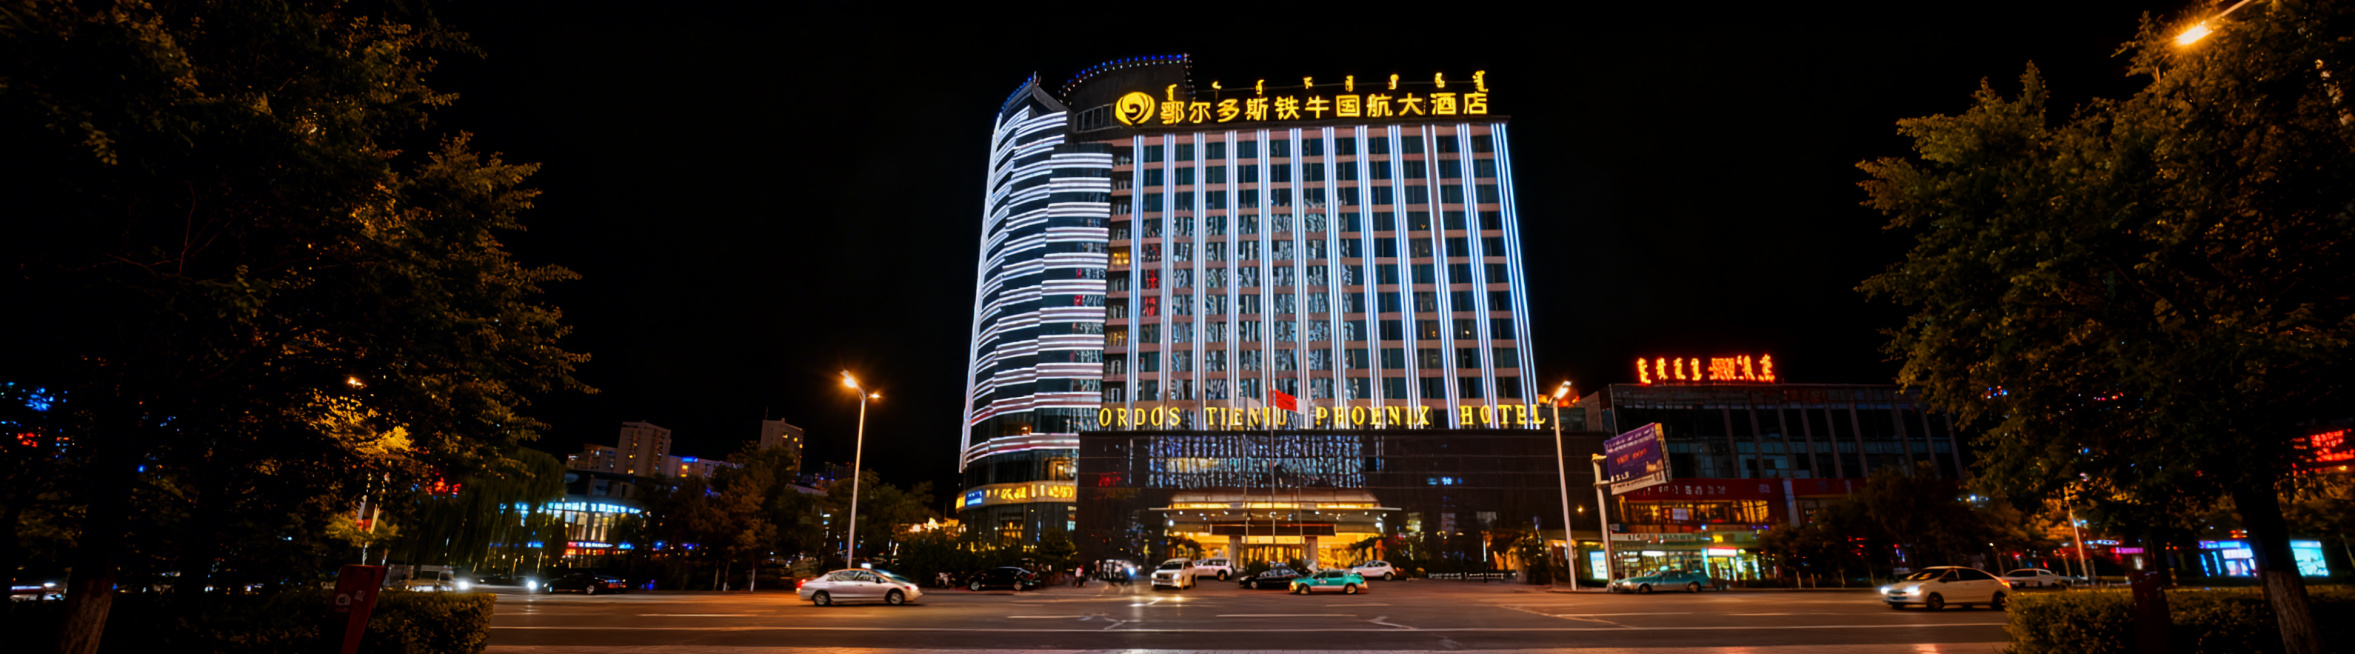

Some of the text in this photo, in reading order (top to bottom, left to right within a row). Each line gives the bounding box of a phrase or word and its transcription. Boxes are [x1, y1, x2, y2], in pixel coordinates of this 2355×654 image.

[1160, 93, 1487, 125] 鄂尔多斯铁牛国航大酒店
[1098, 406, 1181, 427] ORDOS
[1315, 405, 1430, 426] PHOENIX
[1459, 404, 1546, 425] HOTEL
